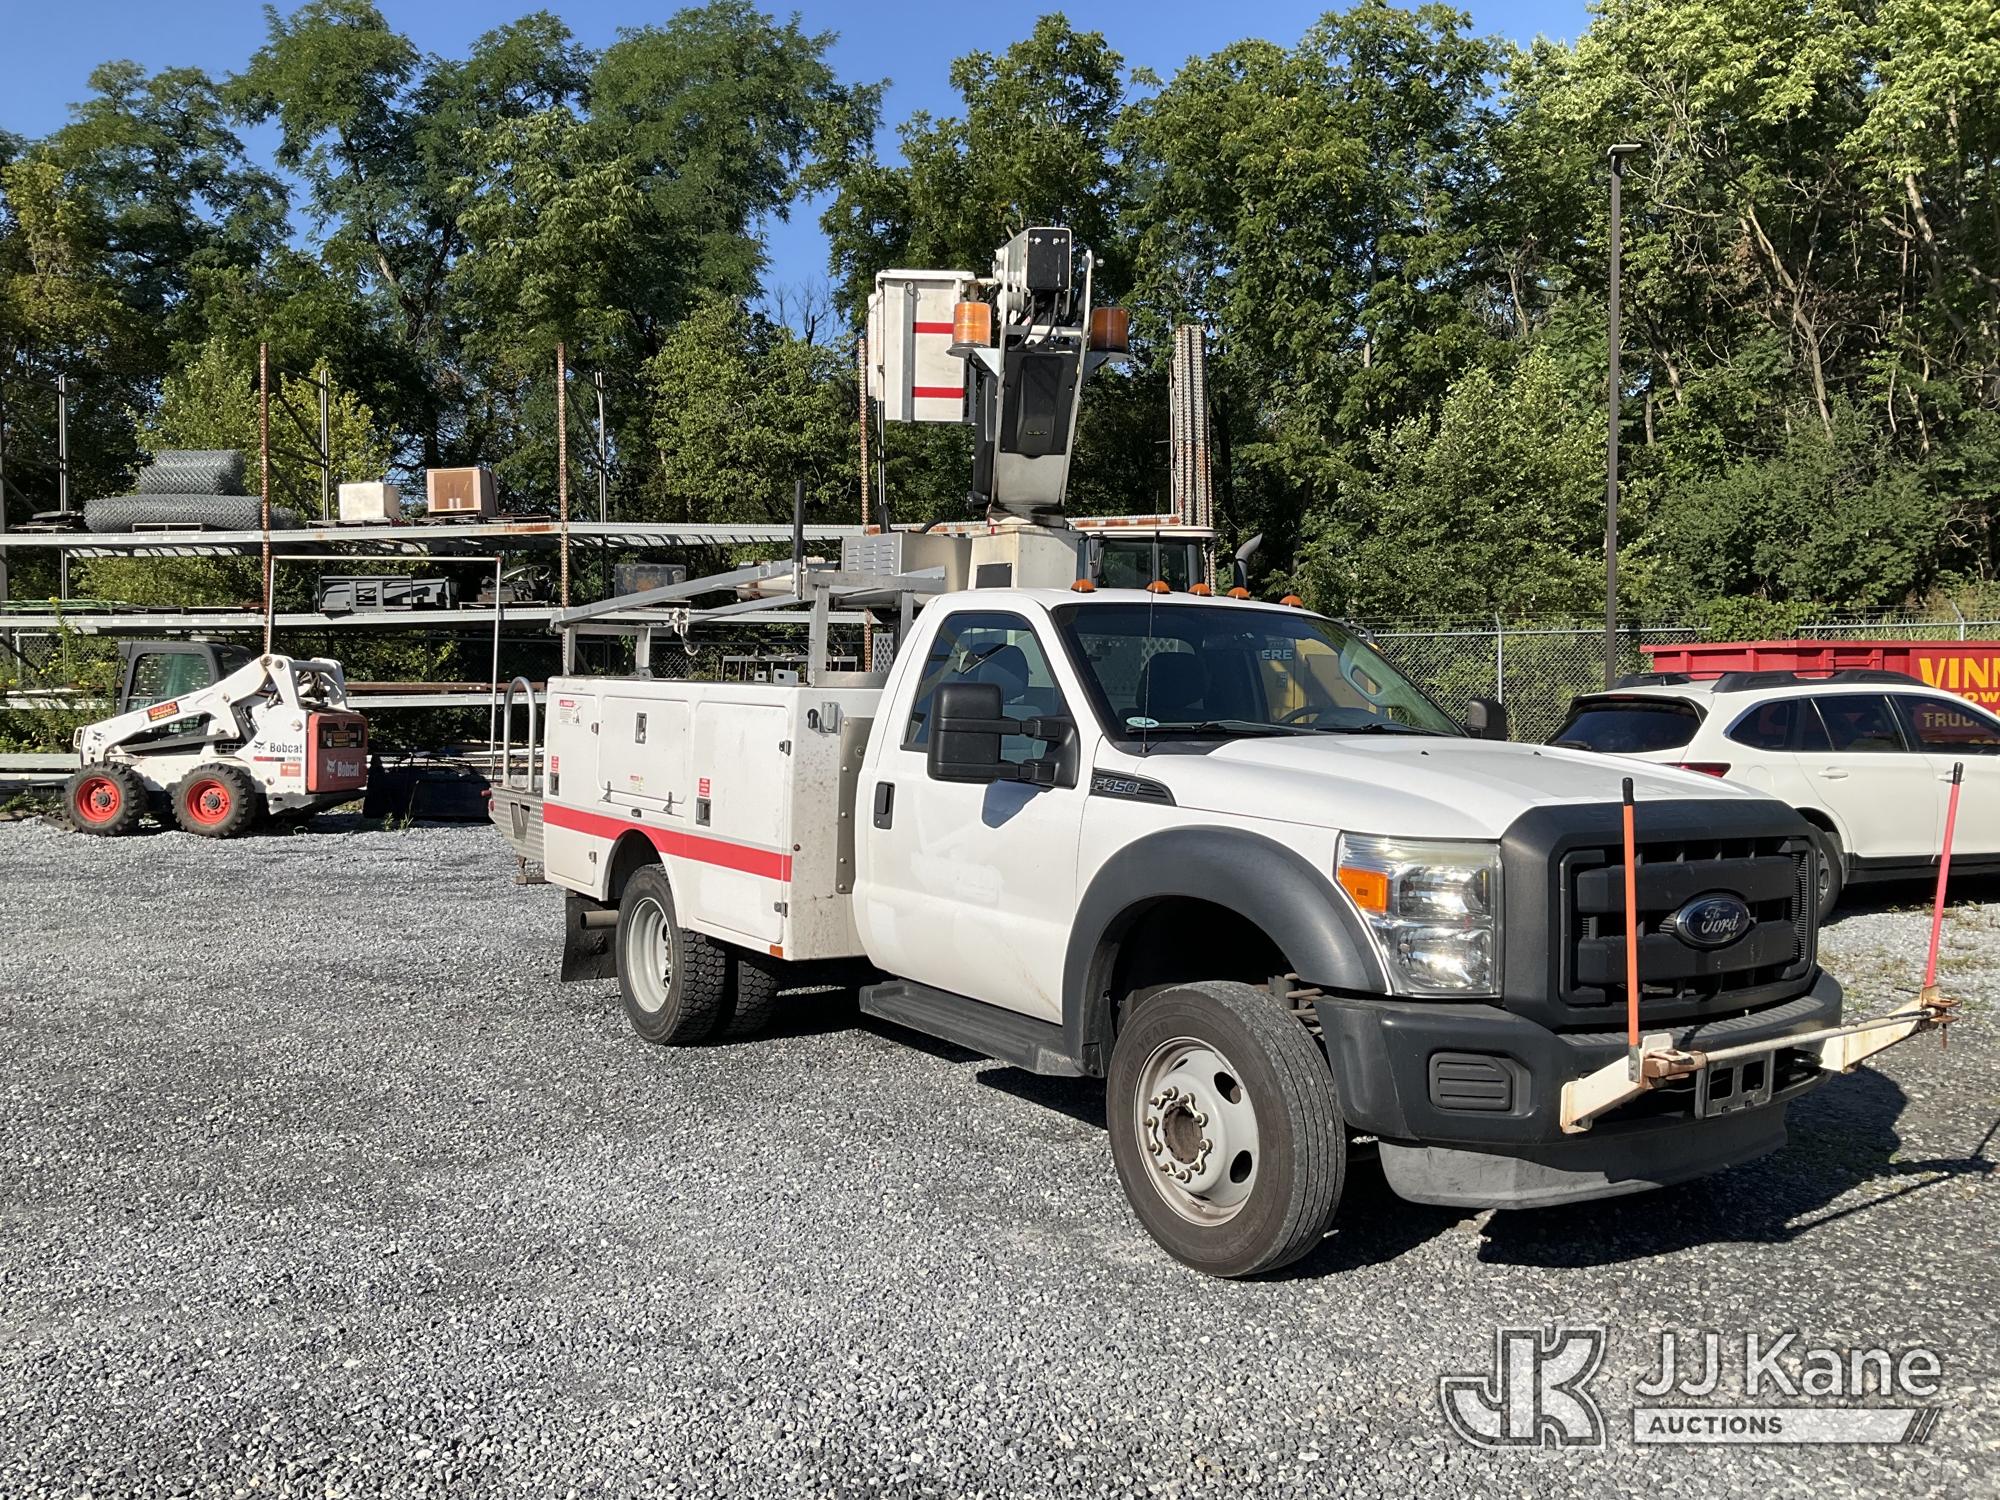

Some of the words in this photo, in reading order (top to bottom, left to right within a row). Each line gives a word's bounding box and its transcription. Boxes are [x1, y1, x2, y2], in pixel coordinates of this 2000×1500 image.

[1955, 692, 2000, 703] OW
[1921, 712, 1980, 728] TRUC
[269, 742, 303, 754] Bobcat
[337, 761, 360, 777] Bobcat
[1701, 906, 1740, 934] Ford
